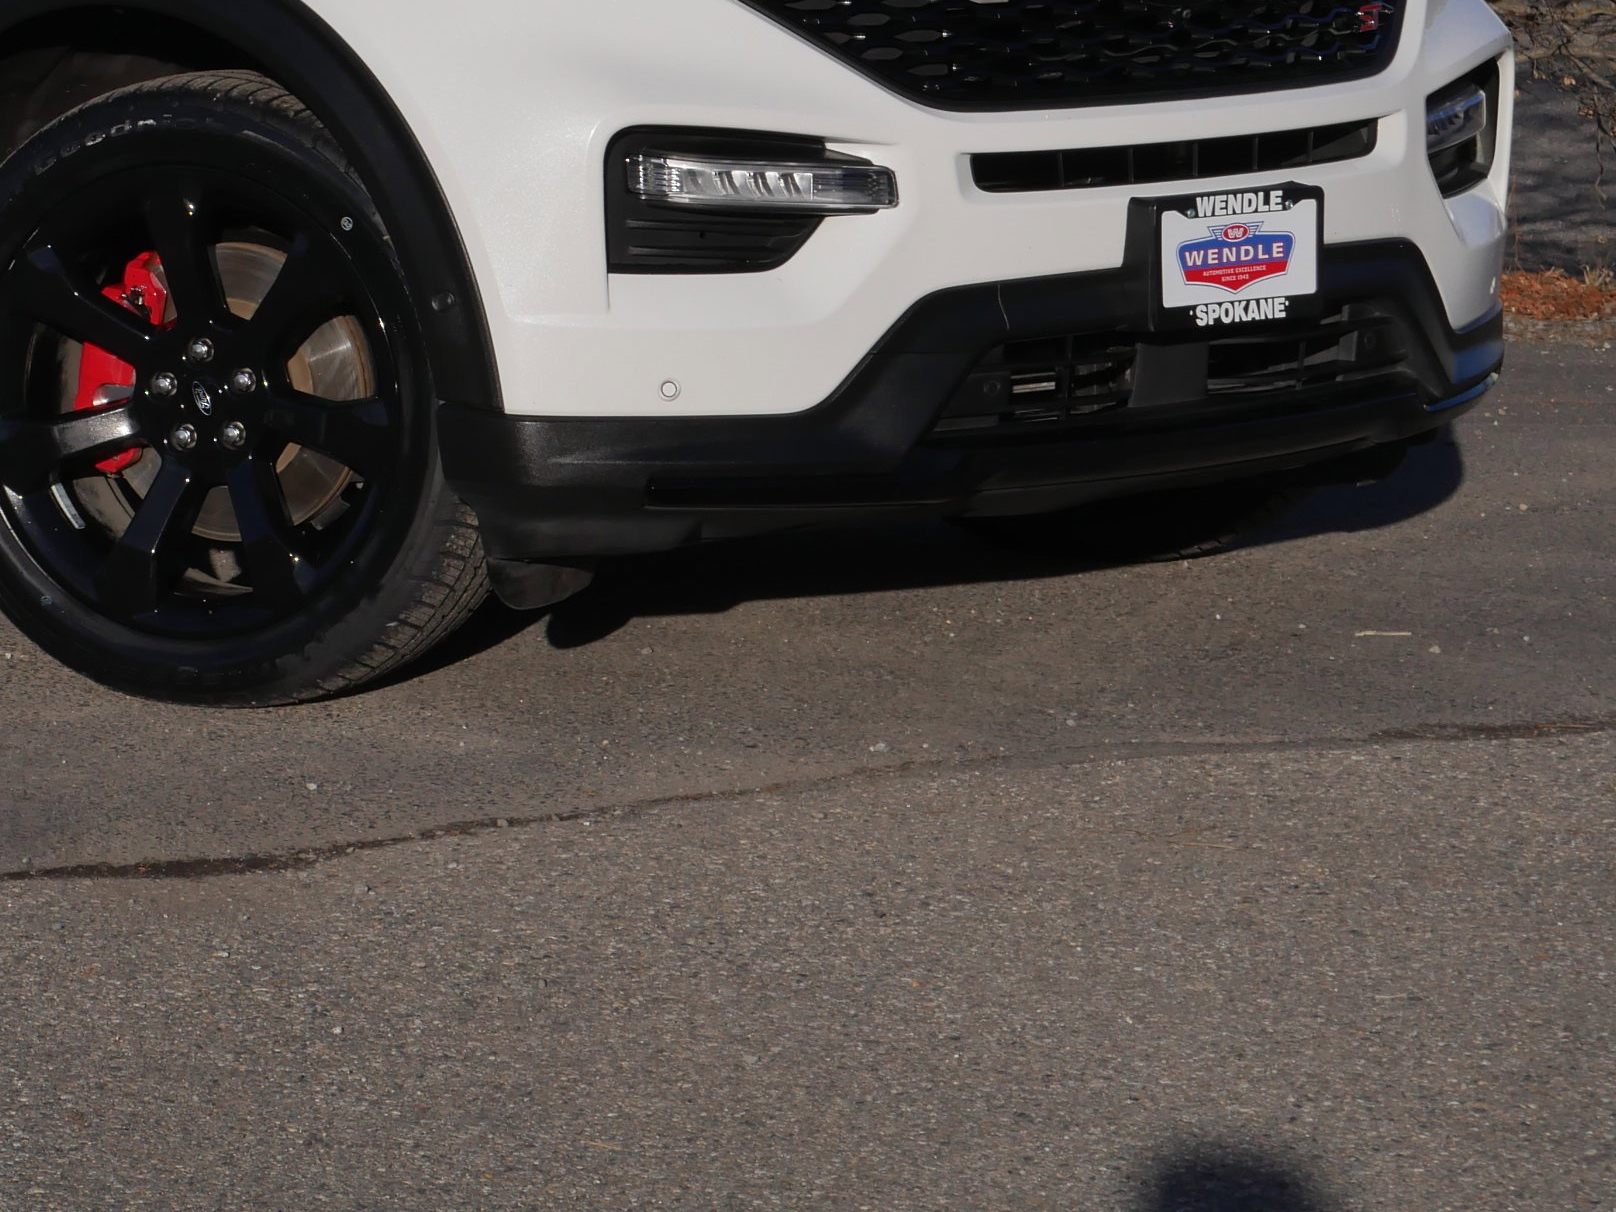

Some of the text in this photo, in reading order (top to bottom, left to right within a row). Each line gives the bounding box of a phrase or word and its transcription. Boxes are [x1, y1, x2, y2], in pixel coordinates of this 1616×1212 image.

[1196, 190, 1283, 218] WENDLE
[1185, 242, 1284, 267] WENDLE
[1202, 265, 1266, 277] AUTOMOTIVE EXCELLENCE
[1195, 297, 1287, 327] SPOKANE
